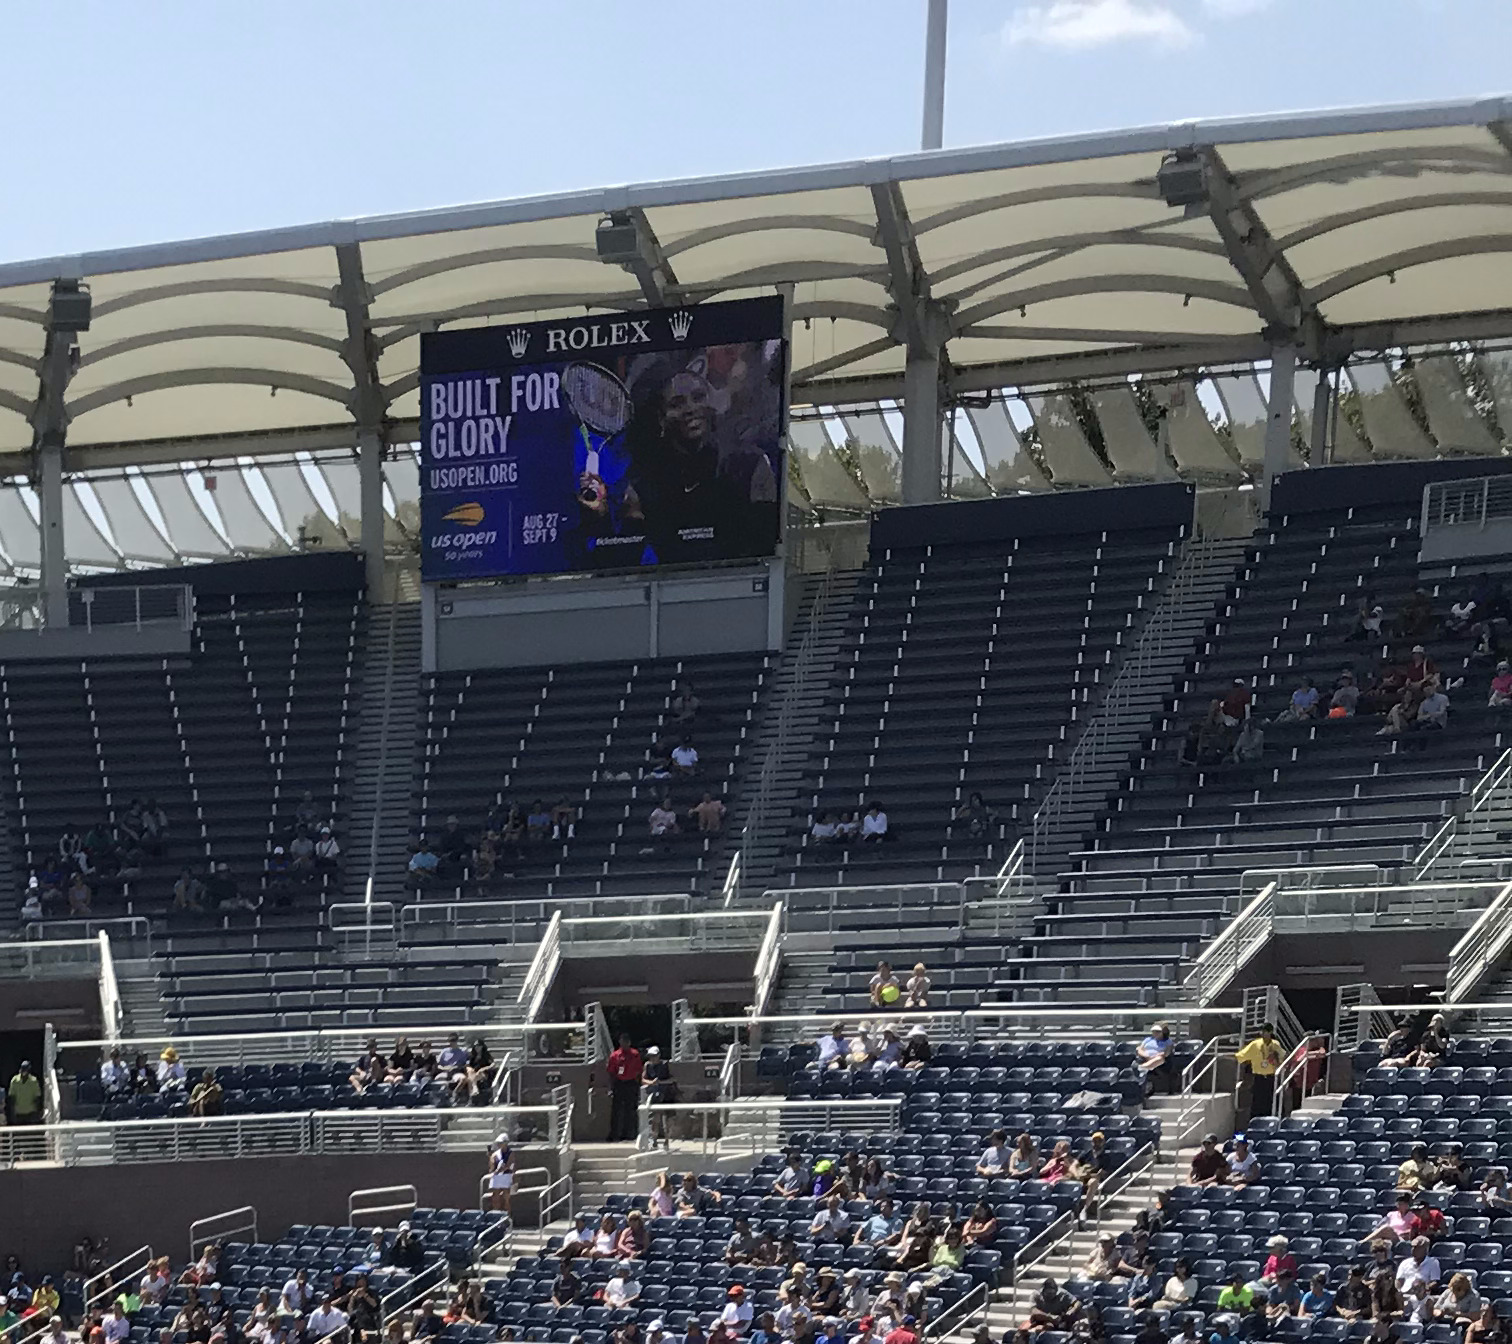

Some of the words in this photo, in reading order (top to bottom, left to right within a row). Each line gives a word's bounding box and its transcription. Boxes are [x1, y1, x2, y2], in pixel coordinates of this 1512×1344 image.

[546, 319, 652, 353] ROLEX
[430, 377, 501, 420] BUILT
[511, 372, 561, 413] FOR
[430, 415, 512, 459] GLORY
[430, 462, 518, 489] USOPEN.ORG
[523, 514, 544, 530] AUG
[546, 513, 559, 528] 27
[431, 534, 451, 549] us
[452, 530, 498, 550] open
[523, 529, 547, 545] SEPT
[550, 527, 558, 543] 9
[444, 551, 458, 561] 50
[458, 550, 484, 562] years
